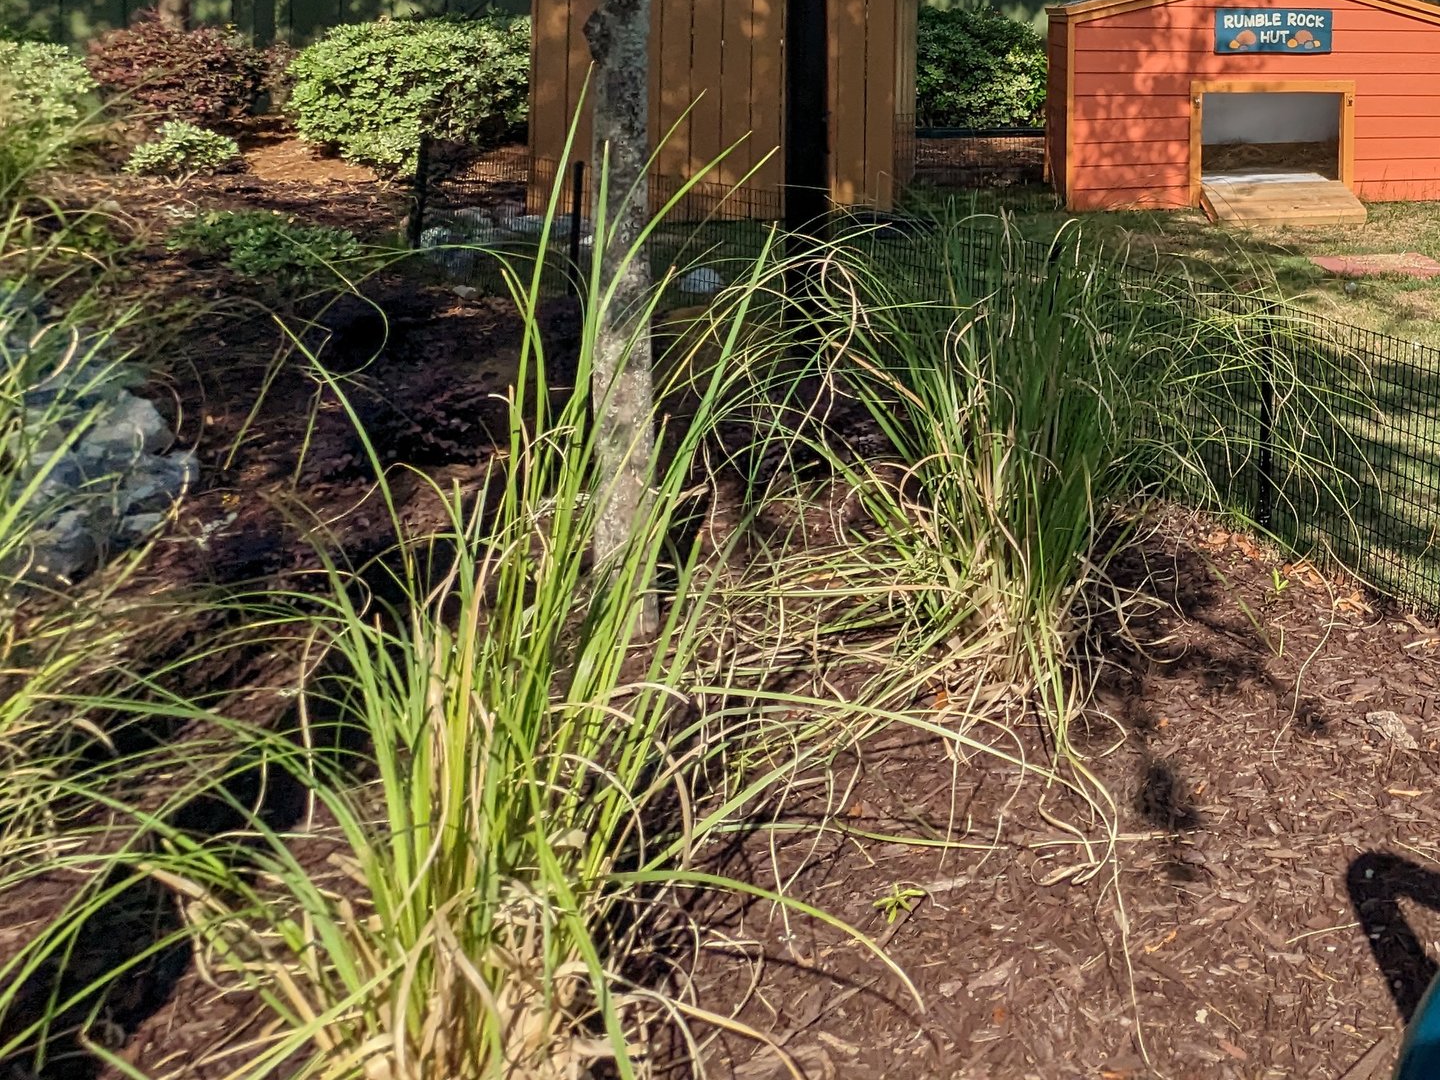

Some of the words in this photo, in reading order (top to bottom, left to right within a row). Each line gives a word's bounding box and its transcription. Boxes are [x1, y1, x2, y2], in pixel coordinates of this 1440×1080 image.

[1223, 13, 1282, 29] RUMBLE
[1287, 12, 1325, 28] ROCK
[1260, 30, 1290, 44] HUT
